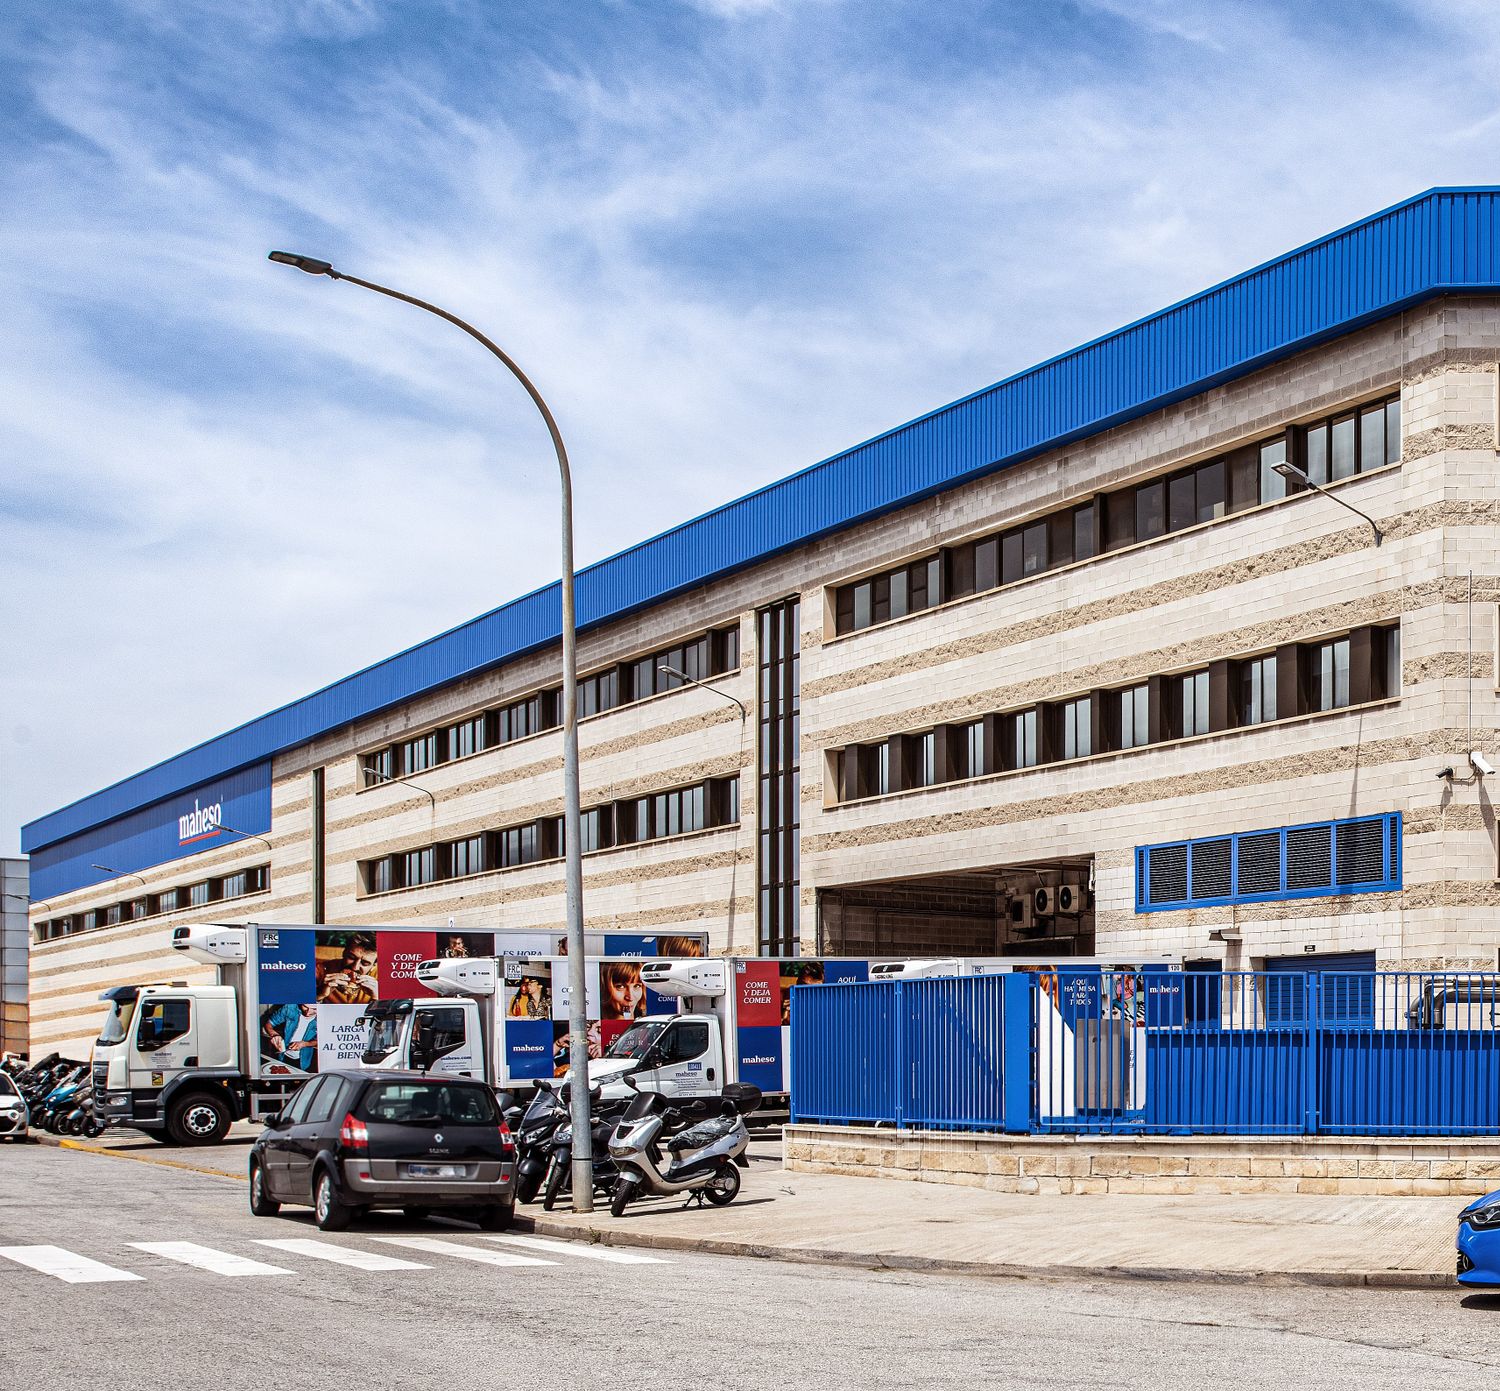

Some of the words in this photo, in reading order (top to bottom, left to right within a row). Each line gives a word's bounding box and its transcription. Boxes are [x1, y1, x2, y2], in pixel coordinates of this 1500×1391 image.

[179, 798, 222, 840] maheso
[393, 953, 423, 961] COME
[260, 960, 307, 971] maheso
[391, 962, 399, 970] Y
[390, 970, 417, 979] COM
[745, 981, 769, 989] COME
[743, 996, 772, 1004] COMER
[331, 1025, 366, 1033] LARGA
[336, 1034, 361, 1042] VIDA
[322, 1043, 336, 1051] AL
[338, 1043, 368, 1051] COME
[512, 1044, 545, 1052] maheso
[337, 1051, 361, 1060] BIEN
[742, 1055, 775, 1064] maheso
